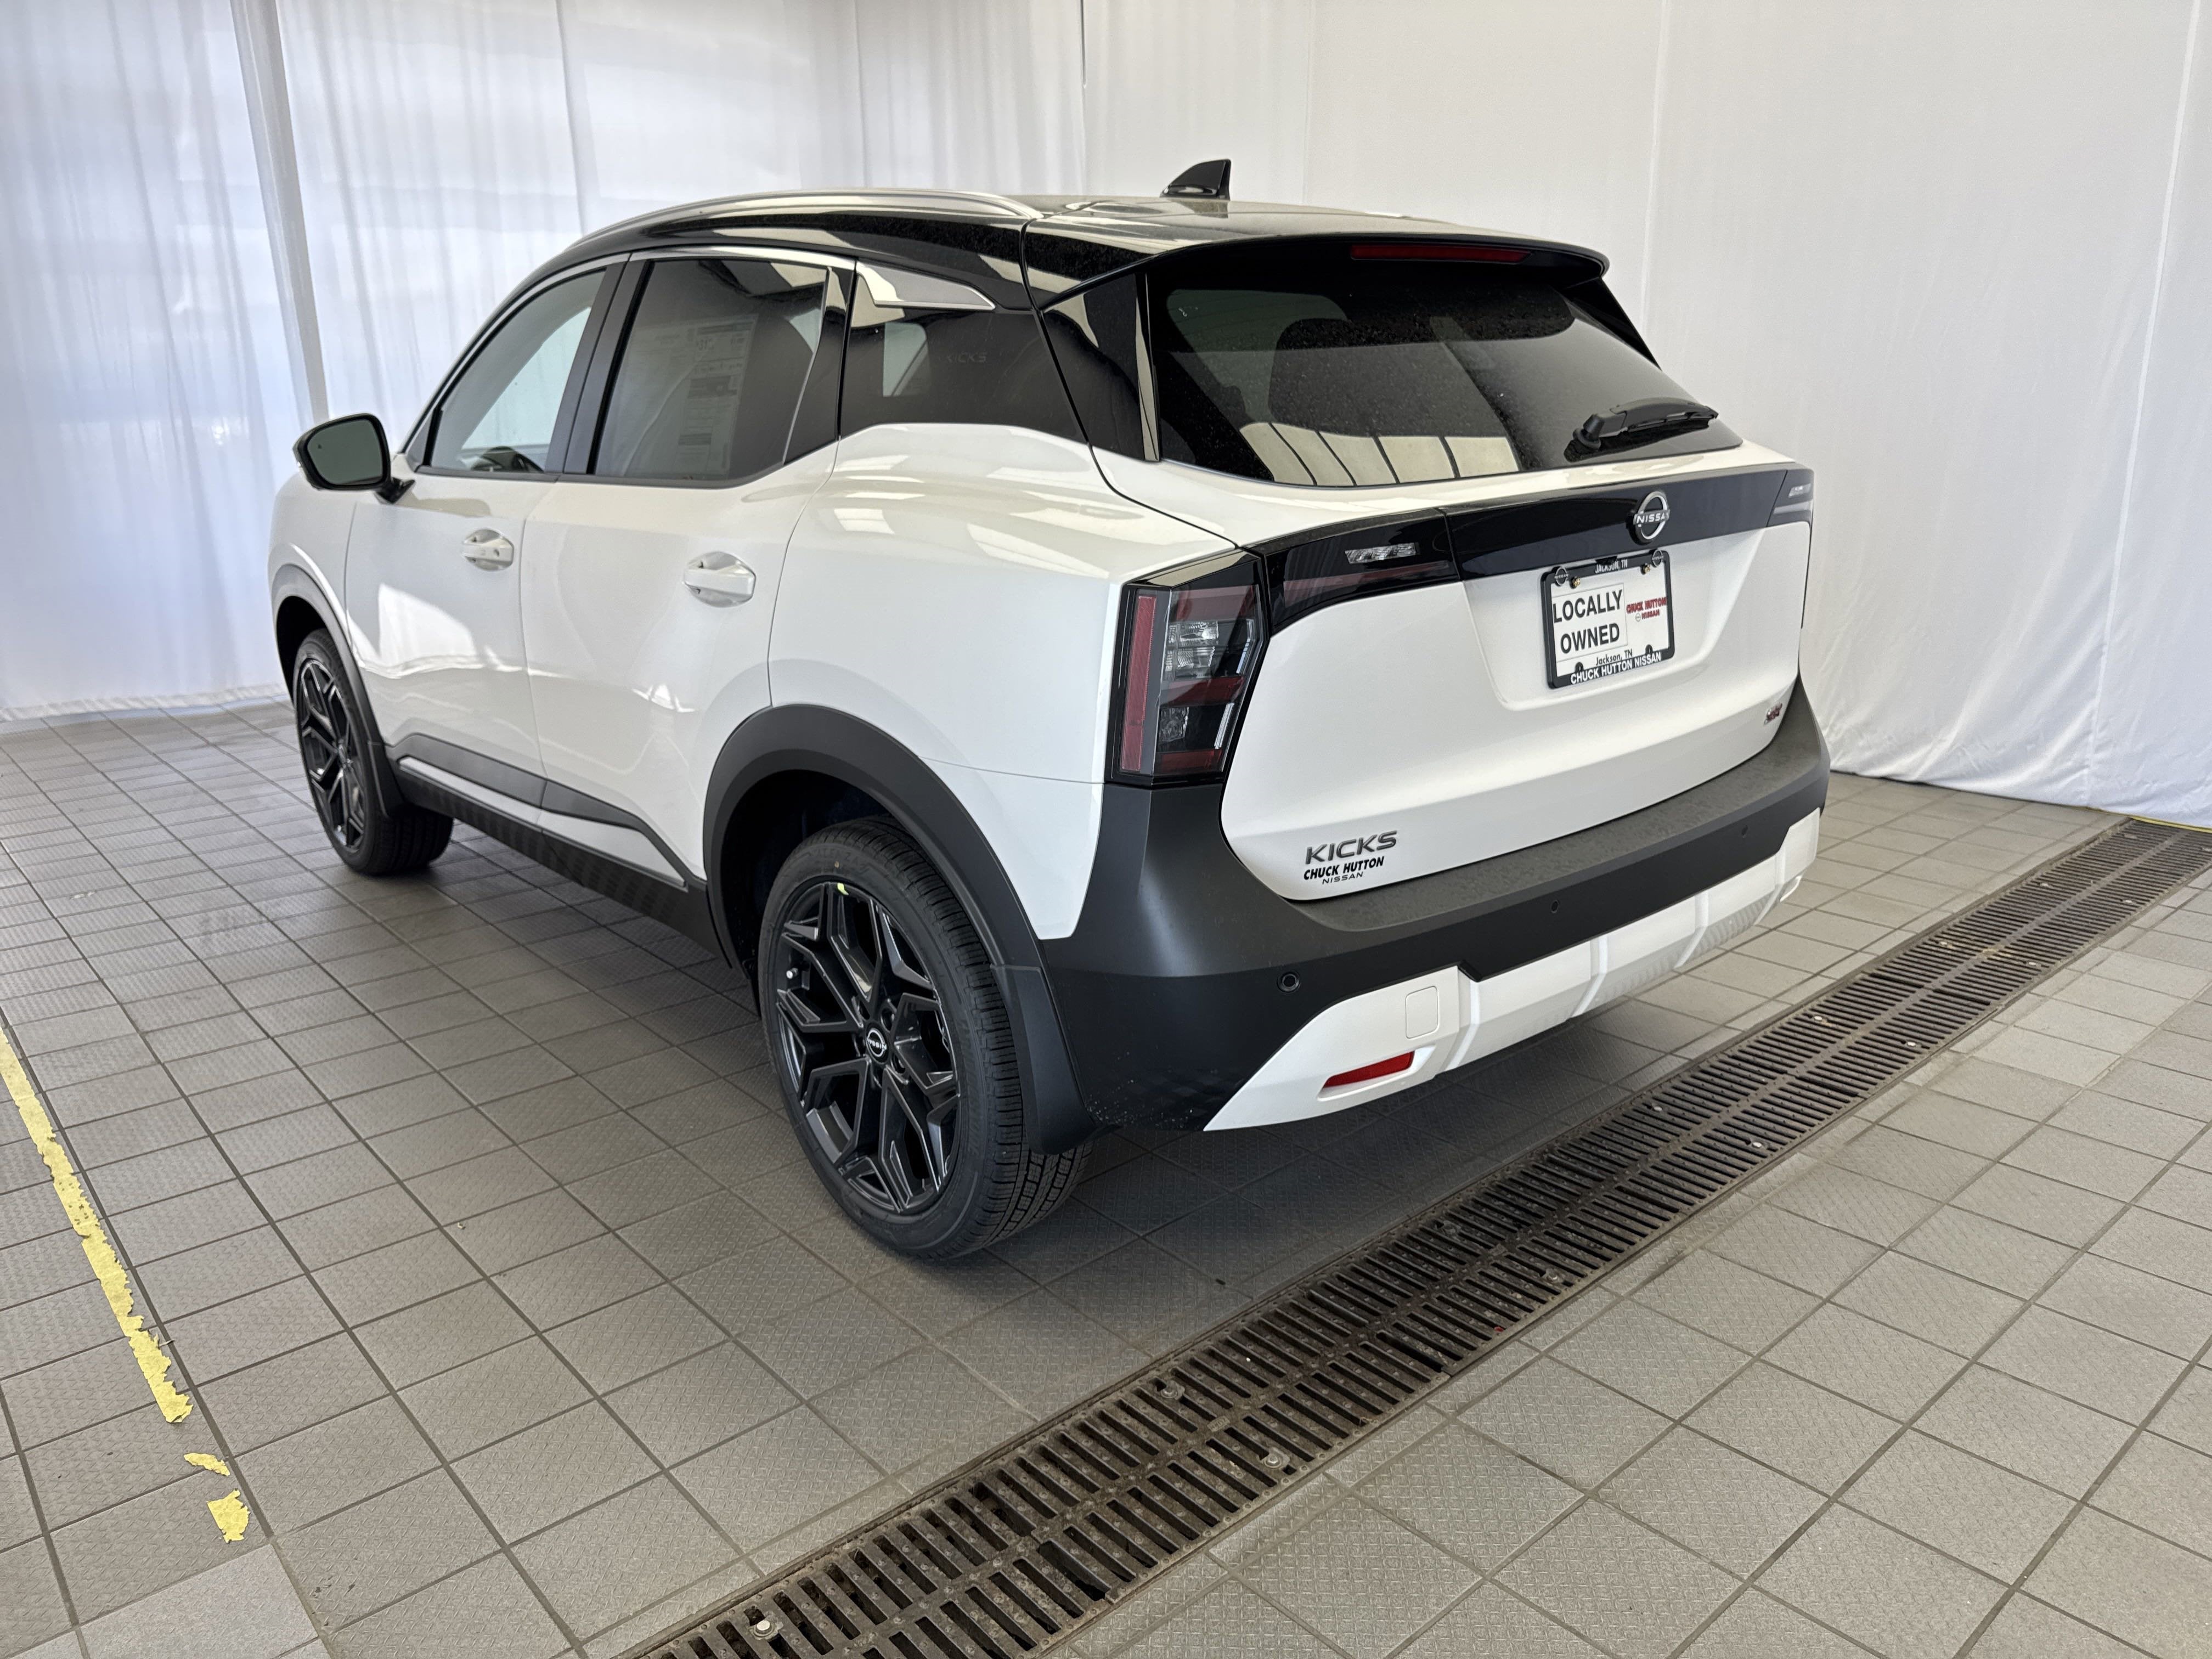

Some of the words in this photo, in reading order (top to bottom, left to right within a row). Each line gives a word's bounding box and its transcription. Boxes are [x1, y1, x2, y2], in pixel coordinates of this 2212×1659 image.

[946, 351, 988, 364] KICKS
[1636, 512, 1670, 523] NISSAN
[1621, 558, 1628, 568] TN
[1553, 589, 1622, 623] LOCALLY
[1626, 602, 1644, 614] CHUCK
[1645, 596, 1667, 610] HUTTON
[1641, 609, 1660, 619] NISSAN
[1560, 623, 1620, 653] OWNED
[1596, 654, 1622, 666] Jackson,
[1624, 648, 1633, 658] TN
[1570, 668, 1599, 685] CHUCK
[1601, 659, 1633, 676] HUTTON
[1634, 651, 1661, 668] NISSAN
[1305, 830, 1397, 865] KICKS
[1304, 864, 1339, 881] CHUCK
[1343, 856, 1385, 873] HUTTON
[1322, 872, 1364, 884] NISSAN
